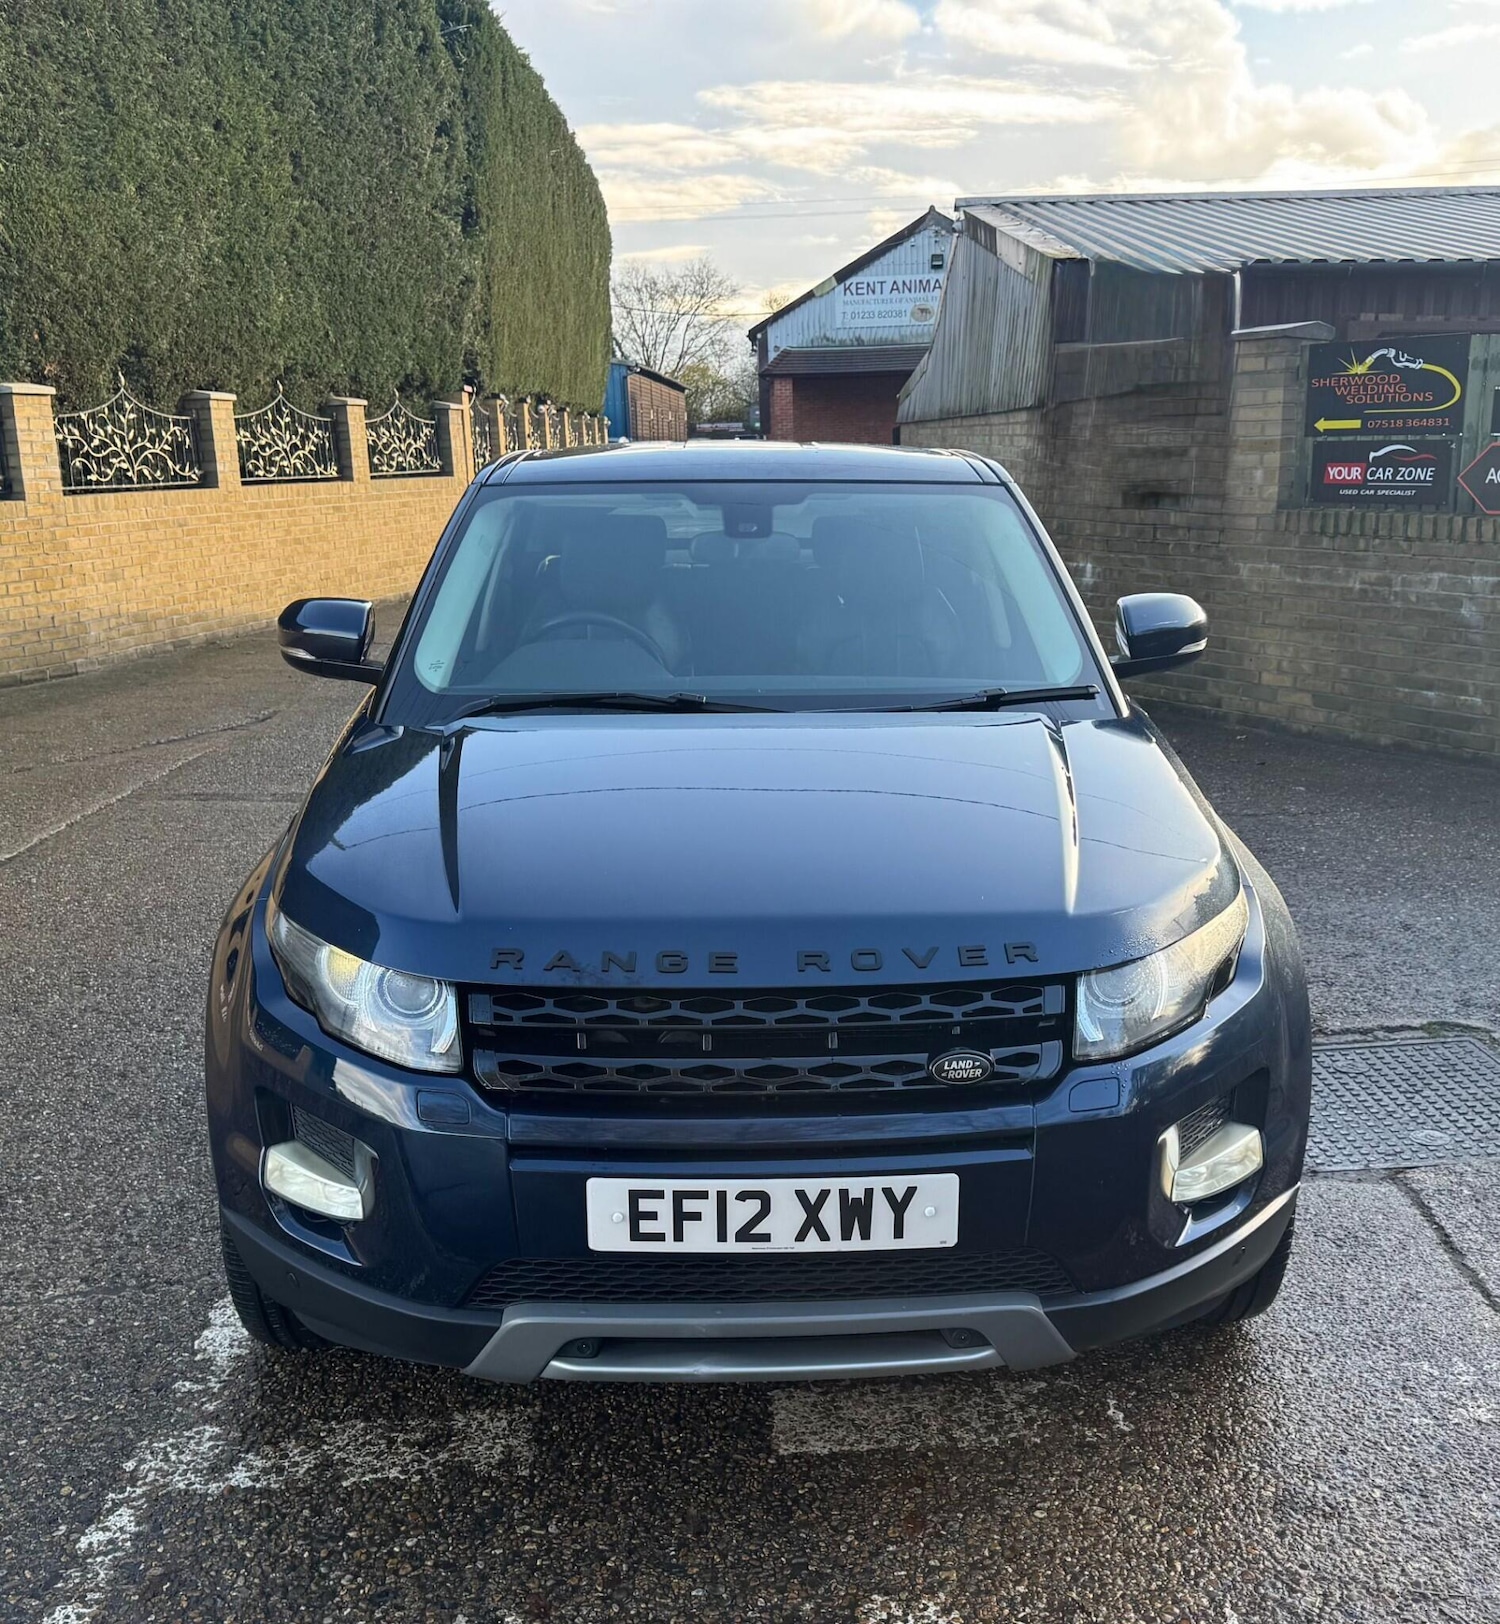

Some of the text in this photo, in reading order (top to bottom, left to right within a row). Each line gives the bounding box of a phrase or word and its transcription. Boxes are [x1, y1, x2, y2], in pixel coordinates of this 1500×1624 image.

[843, 281, 887, 296] KENT
[850, 311, 875, 320] 01233
[877, 310, 908, 319] 820381
[1311, 374, 1401, 388] SHERWOOD
[1335, 383, 1407, 396] WELDING
[1346, 391, 1434, 405] SOLUTIONS
[1367, 418, 1450, 429] 07518 364831
[1327, 466, 1436, 481] YOUR CAR ZONE
[490, 942, 1040, 974] RANGE ROVER
[944, 1060, 973, 1070] LAND
[947, 1068, 983, 1079] ROVER
[628, 1186, 918, 1243] EF12 XWY
